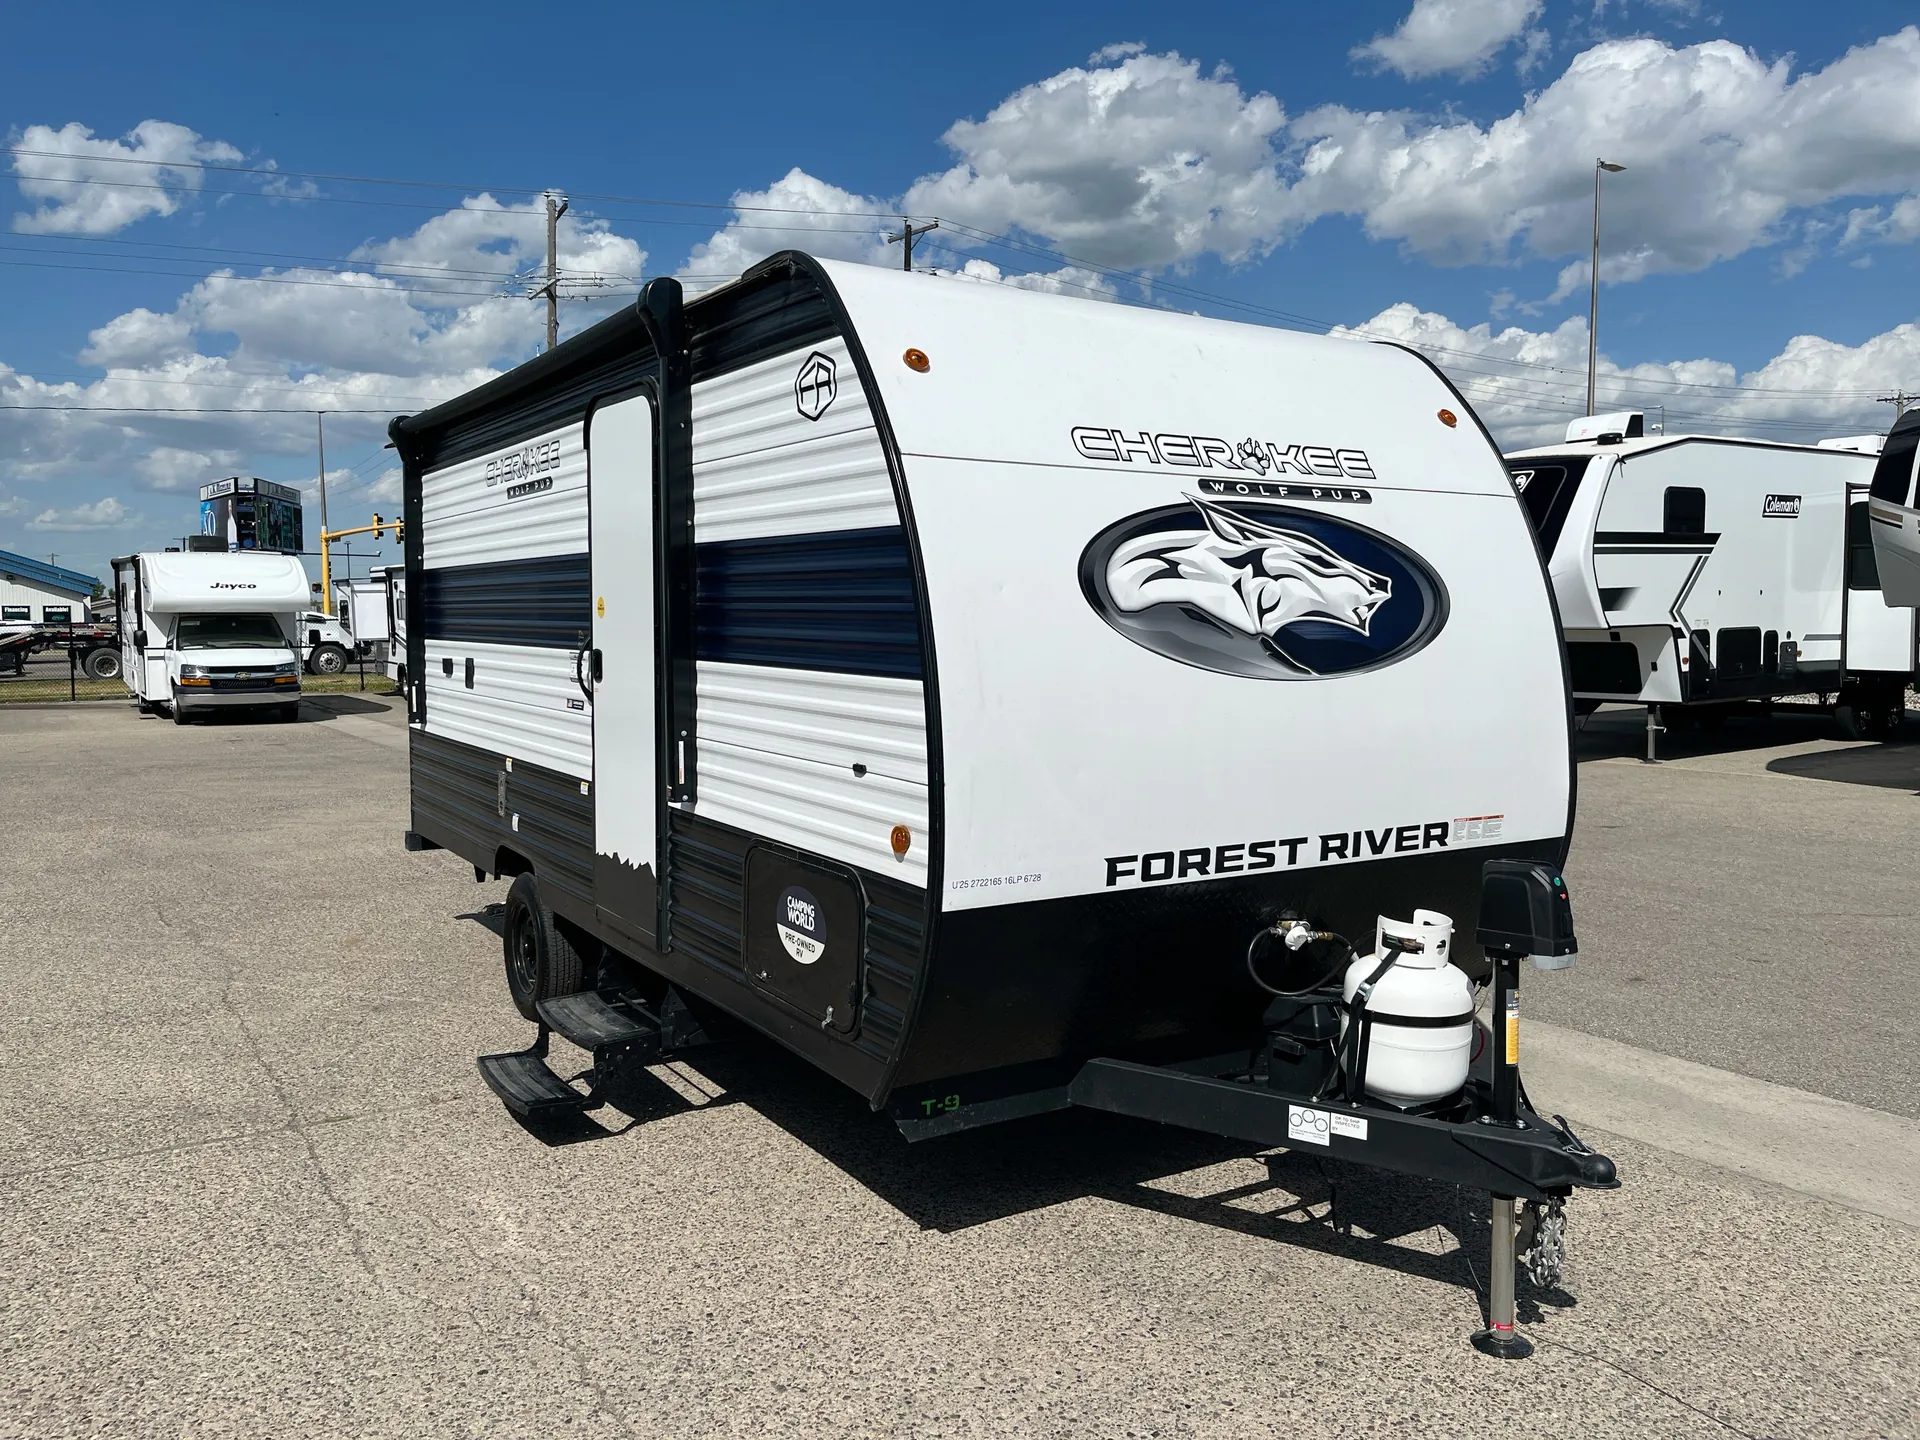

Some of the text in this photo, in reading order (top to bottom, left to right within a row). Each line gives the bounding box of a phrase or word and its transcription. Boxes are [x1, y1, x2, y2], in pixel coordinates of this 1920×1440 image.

[509, 478, 551, 496] WOLF PUP
[1209, 481, 1362, 503] WOLF PUP
[1765, 495, 1794, 513] Coleman
[210, 582, 257, 590] Jayco
[1103, 836, 1308, 887] FOREST
[1318, 821, 1450, 862] RIVER
[970, 876, 1003, 888] 2722165
[1004, 874, 1023, 885] 16LP
[1023, 873, 1042, 884] 6728
[787, 895, 815, 918] CAMPING
[787, 906, 815, 931] WORLD
[784, 931, 816, 954] PRE-OWNED
[795, 947, 804, 958] RV
